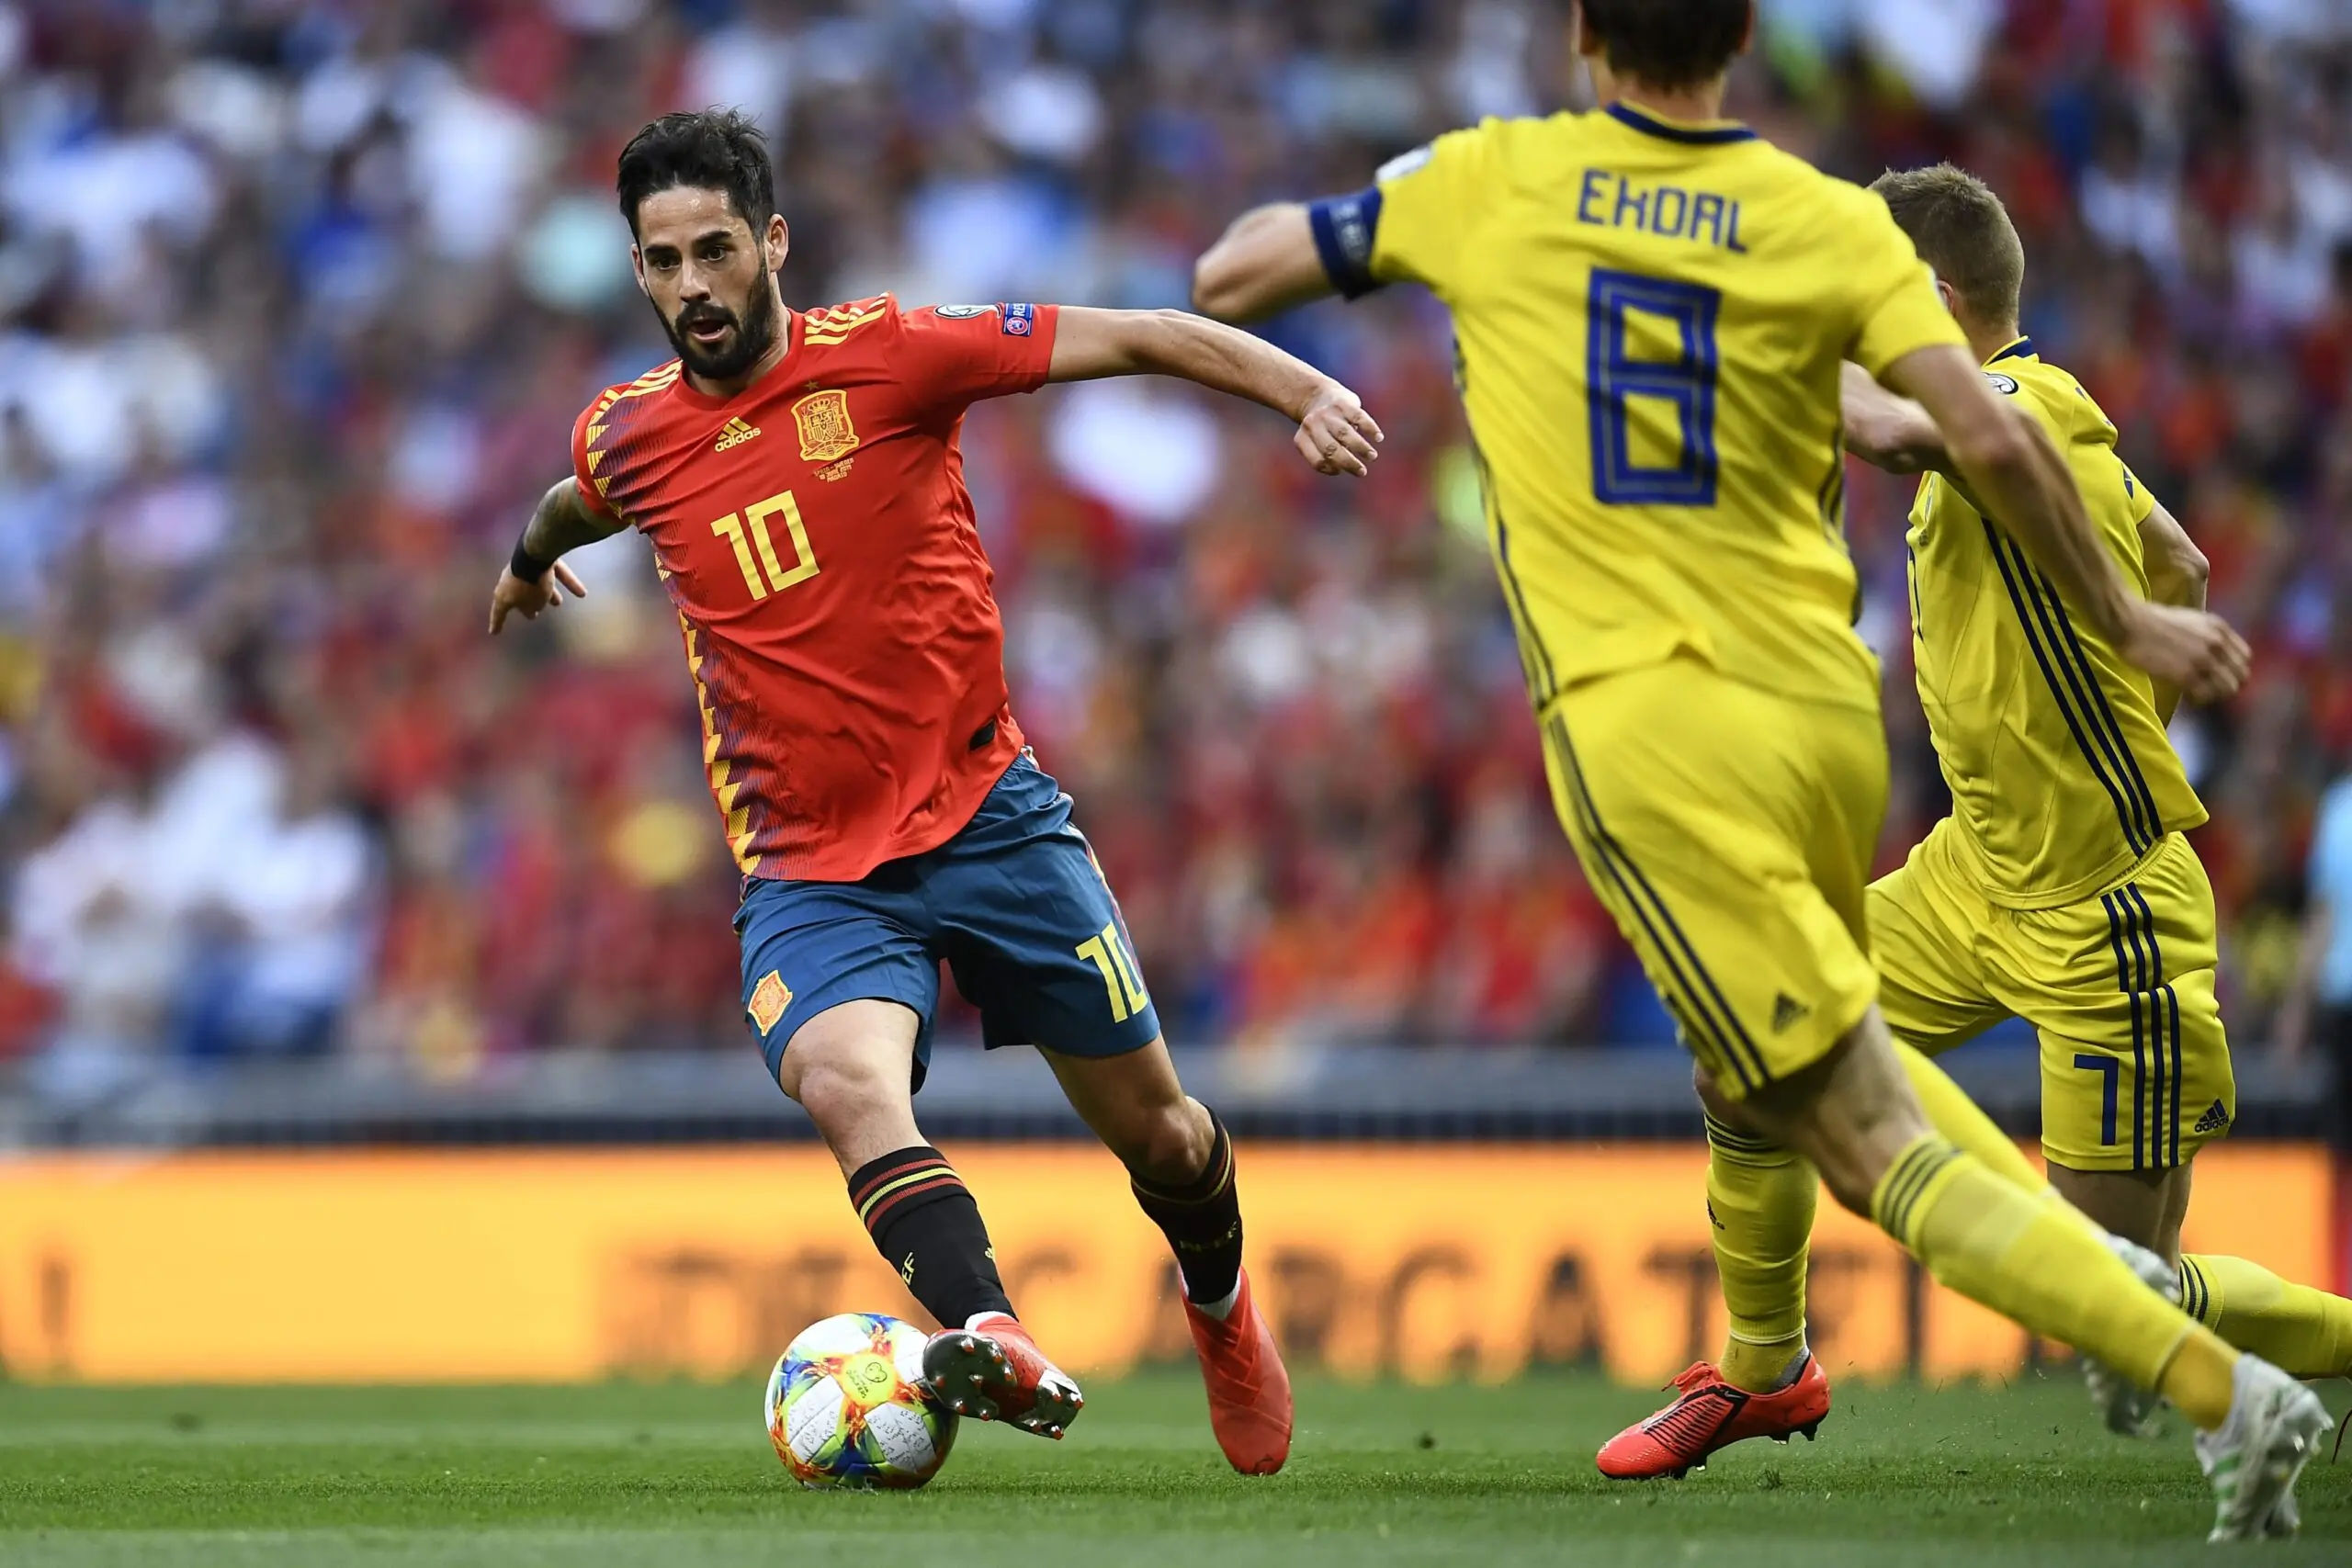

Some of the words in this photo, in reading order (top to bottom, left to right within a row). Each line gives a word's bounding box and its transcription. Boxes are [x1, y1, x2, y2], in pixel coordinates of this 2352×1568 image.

[1577, 169, 1747, 254] EKDAL
[1587, 265, 1722, 506] 8
[715, 427, 762, 453] adidas
[710, 490, 820, 601] 10
[1075, 920, 1148, 1023] 10
[2074, 1054, 2120, 1146] 7
